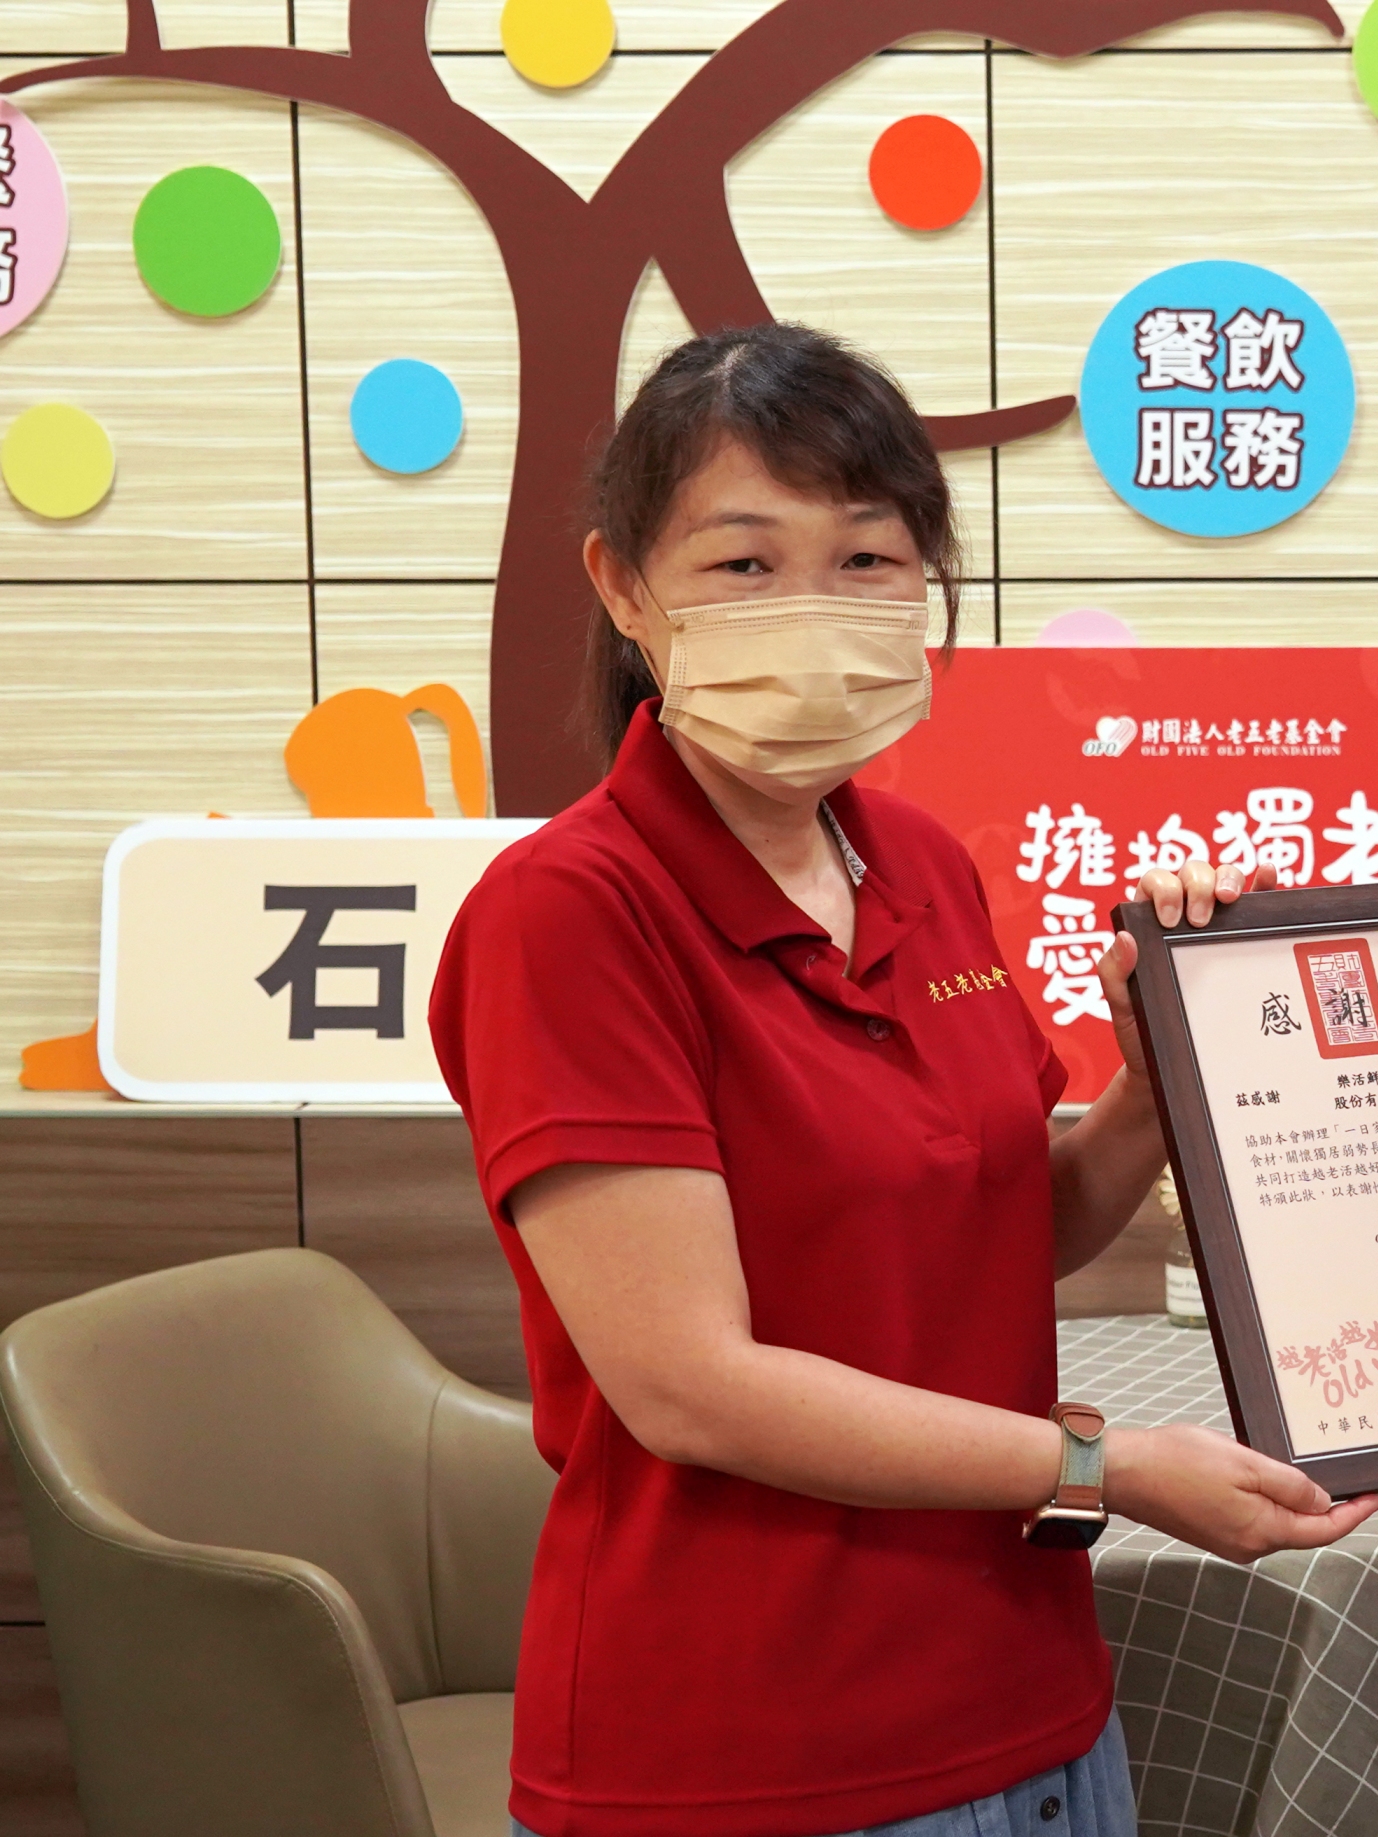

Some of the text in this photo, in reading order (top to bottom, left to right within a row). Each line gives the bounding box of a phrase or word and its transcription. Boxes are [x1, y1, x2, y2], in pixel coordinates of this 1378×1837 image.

[1135, 307, 1304, 390] 餐飲
[1135, 407, 1304, 489] 服務
[1141, 745, 1341, 756] OLD FIVE OLD FOUNDATION
[255, 884, 416, 1039] 石
[1323, 1359, 1373, 1408] Old
